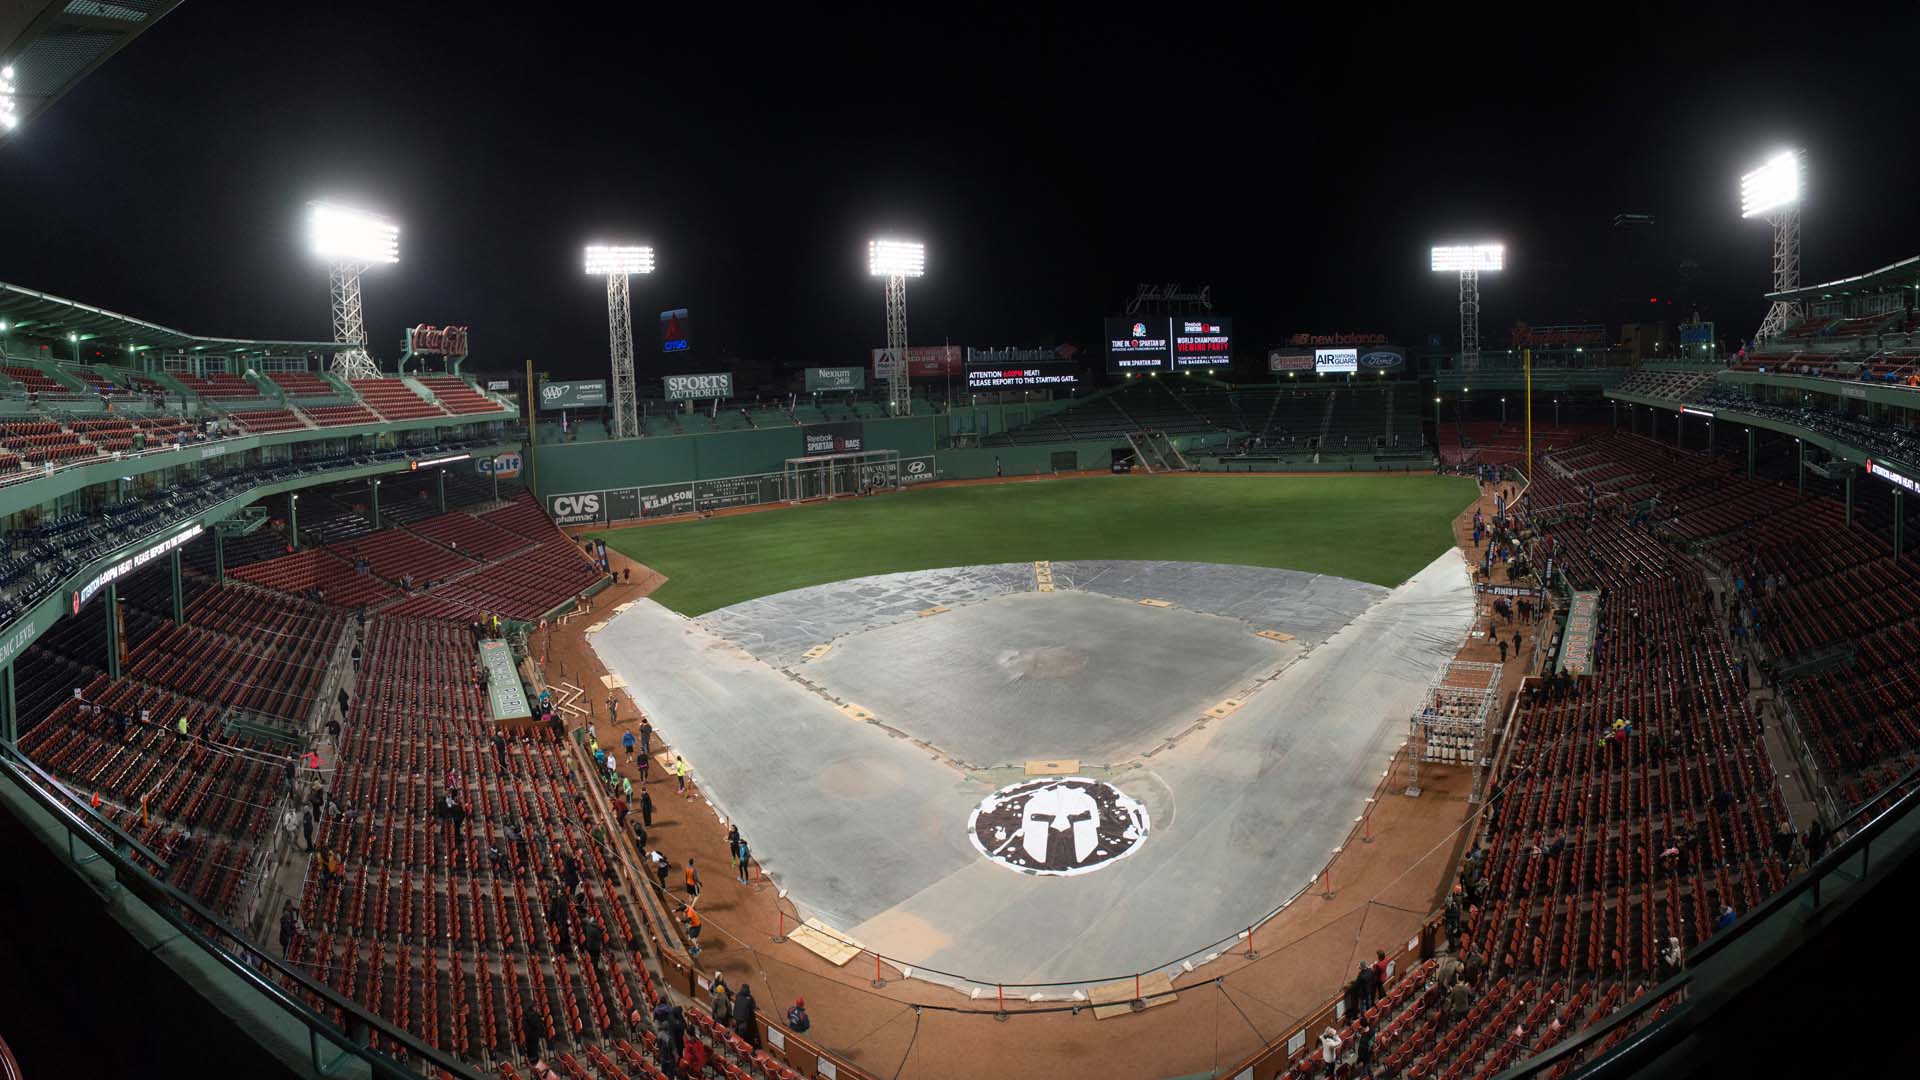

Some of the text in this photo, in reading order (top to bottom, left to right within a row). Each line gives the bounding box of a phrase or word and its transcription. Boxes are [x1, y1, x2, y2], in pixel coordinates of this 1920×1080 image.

[1112, 340, 1124, 348] TUNE
[1139, 339, 1159, 347] SPARTAN
[1177, 342, 1229, 352] VIEWING PARTY
[1119, 359, 1161, 367] WWW.SPARTAN.COM
[1316, 354, 1335, 365] AIR
[1368, 356, 1394, 365] Ford
[818, 368, 850, 378] Nexium
[969, 370, 1002, 379] ATTENTION
[1023, 369, 1040, 377] HEAT!
[668, 374, 729, 392] SPORTS
[969, 379, 991, 387] PLEASE
[992, 378, 1014, 386] REPORT
[1015, 377, 1024, 385] TO
[1035, 375, 1060, 383] STARTING
[670, 387, 729, 399] AUTHORITY
[806, 434, 833, 443] Reebok
[807, 439, 860, 451] SPARTAN RACE
[479, 457, 519, 473] Gulf
[554, 494, 600, 516] CVS
[134, 550, 150, 567] PLEASE
[1494, 587, 1518, 596] FINISH
[15, 621, 36, 649] LEVEL
